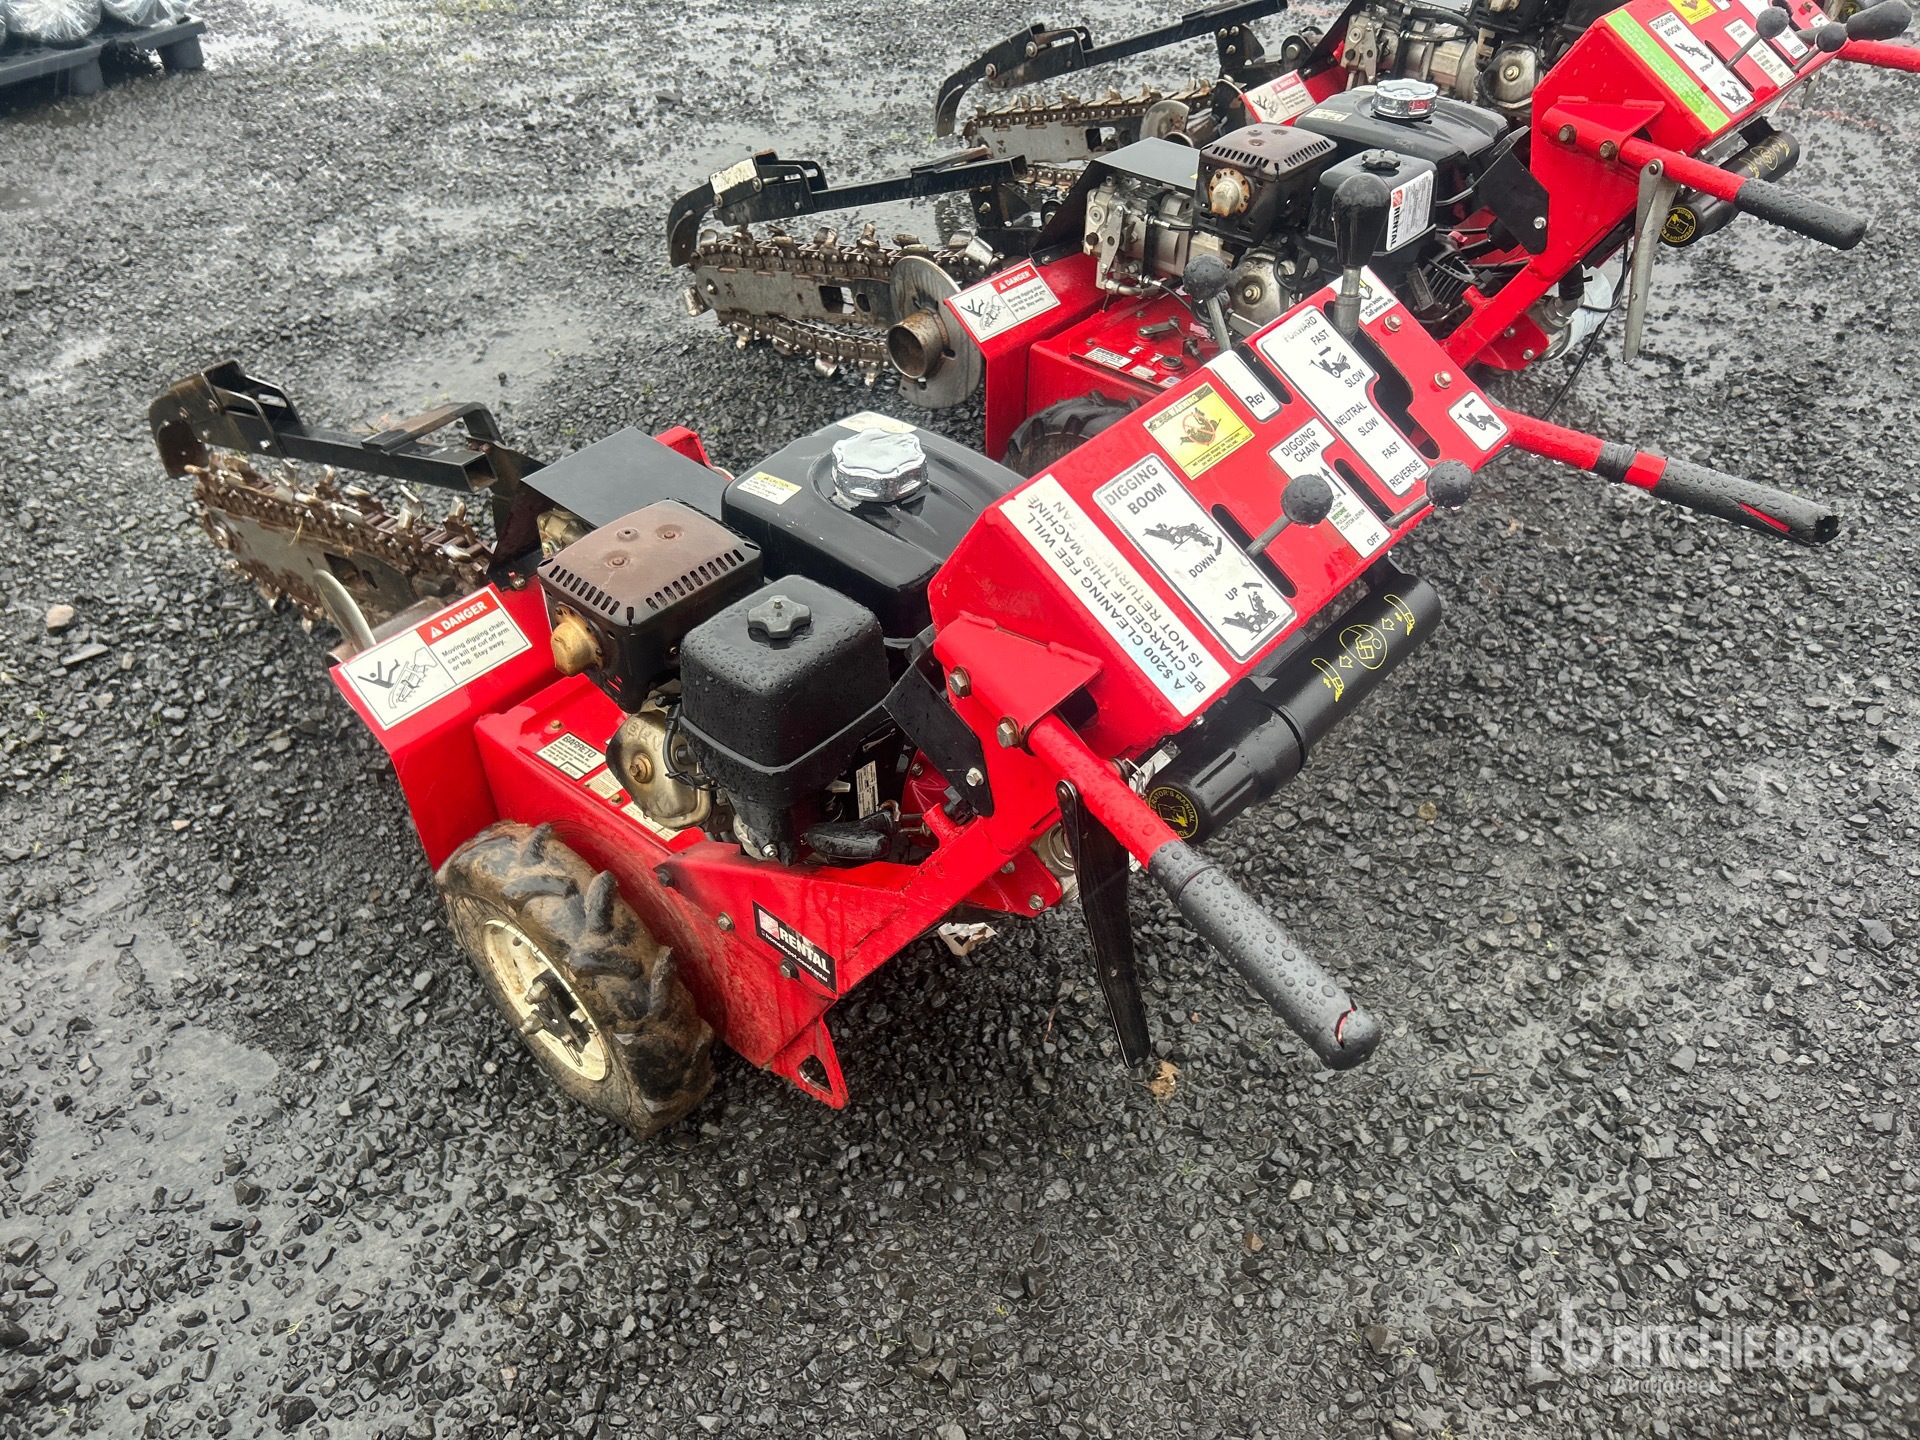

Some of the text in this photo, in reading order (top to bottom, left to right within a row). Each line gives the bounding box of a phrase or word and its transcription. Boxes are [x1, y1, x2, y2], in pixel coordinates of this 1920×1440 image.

[1652, 15, 1676, 29] DIGGING
[1664, 24, 1682, 36] BOOM
[1390, 206, 1400, 247] RENTAL
[1005, 271, 1031, 286] DANGER
[1284, 316, 1317, 342] FORWARD
[1310, 329, 1330, 345] FAST
[1344, 369, 1366, 388] SLOW
[1166, 393, 1200, 417] WARNING
[1334, 402, 1367, 427] NEUTRAL
[1358, 417, 1379, 436] SLOW
[1281, 428, 1316, 457] DIGGING
[1294, 440, 1320, 462] CHAIN
[1382, 441, 1400, 459] FAST
[1104, 464, 1158, 506] DIGGING
[1389, 459, 1421, 488] REVERSE
[1127, 483, 1167, 515] BOOM
[1331, 506, 1348, 521] BEFORE
[1336, 512, 1352, 526] PULLING
[1352, 507, 1366, 520] LEVER
[1366, 532, 1380, 546] OFF
[1188, 554, 1216, 578] DOWN
[1028, 495, 1206, 693] BE CHARGED IF THIS MACHINE
[1028, 513, 1185, 689] A $200 CLEANING FEE WILL
[1225, 587, 1239, 601] UP
[440, 601, 488, 631] DANGER
[442, 620, 505, 657] Moving digging chain
[448, 655, 459, 664] can
[459, 648, 470, 657] kill
[478, 638, 488, 648] cut
[488, 633, 497, 642] off
[497, 628, 510, 636] arm
[1159, 624, 1189, 652] NOT
[460, 658, 472, 666] leg.
[474, 649, 488, 659] Stay
[489, 640, 505, 651] away.
[1188, 652, 1203, 668] IS
[562, 736, 597, 758] BARRETO
[1150, 790, 1195, 822] ERATOR'S MANUAL
[779, 927, 830, 974] RENTAL
